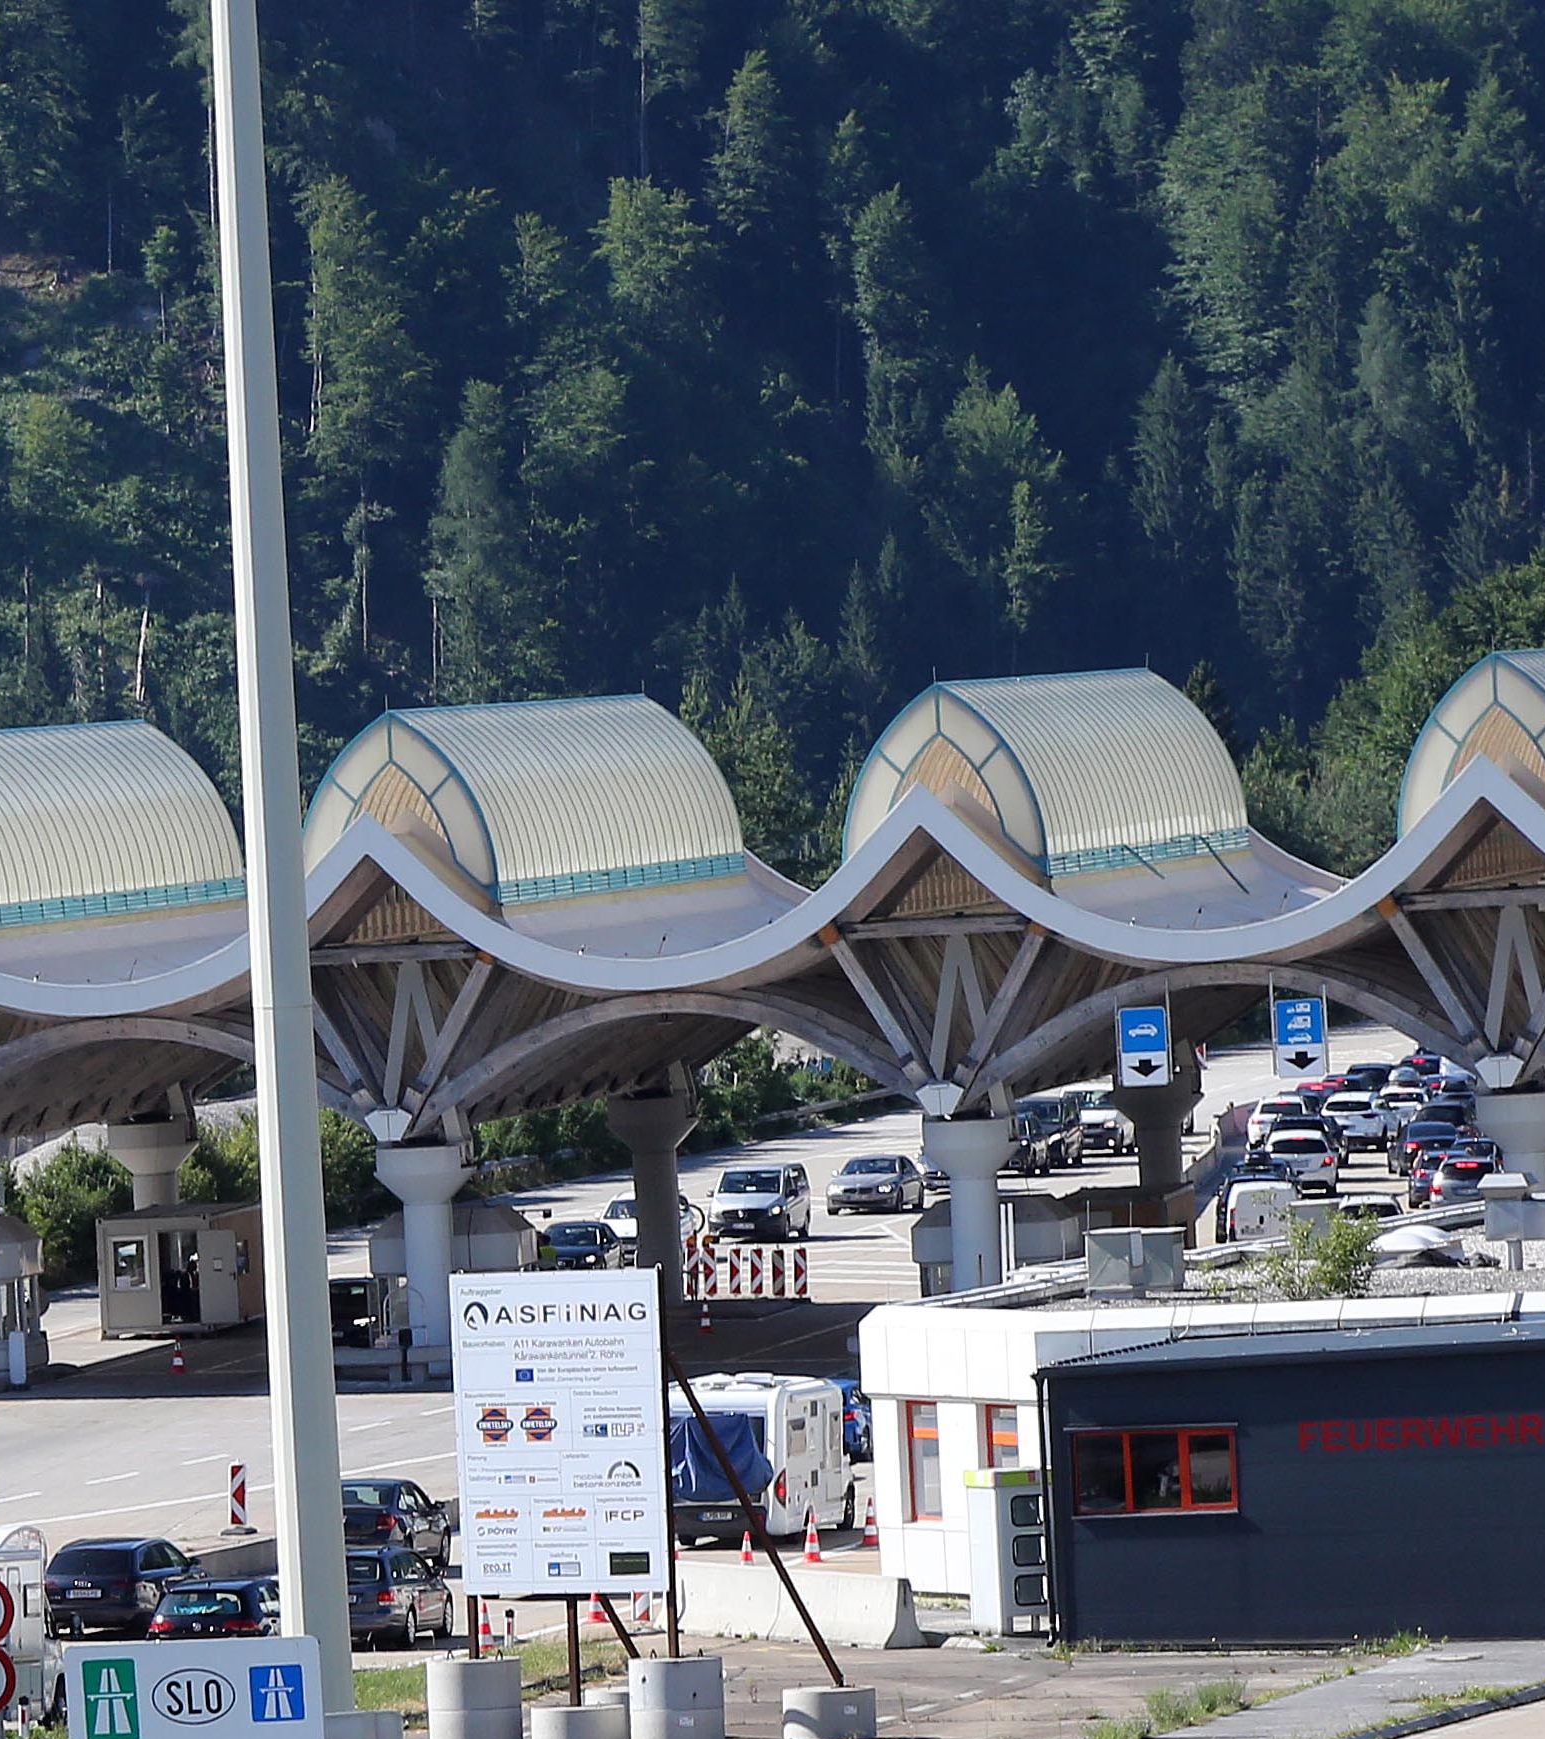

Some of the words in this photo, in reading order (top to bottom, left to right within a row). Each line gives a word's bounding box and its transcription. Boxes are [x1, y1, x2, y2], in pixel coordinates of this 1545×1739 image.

[513, 1339, 529, 1349] A11
[531, 1338, 584, 1348] Karawanken
[585, 1336, 625, 1347] Autobahn
[1298, 1413, 1545, 1452] FEUERWEHR
[573, 1479, 642, 1490] betonkonzepte
[166, 1679, 223, 1716] SLO
